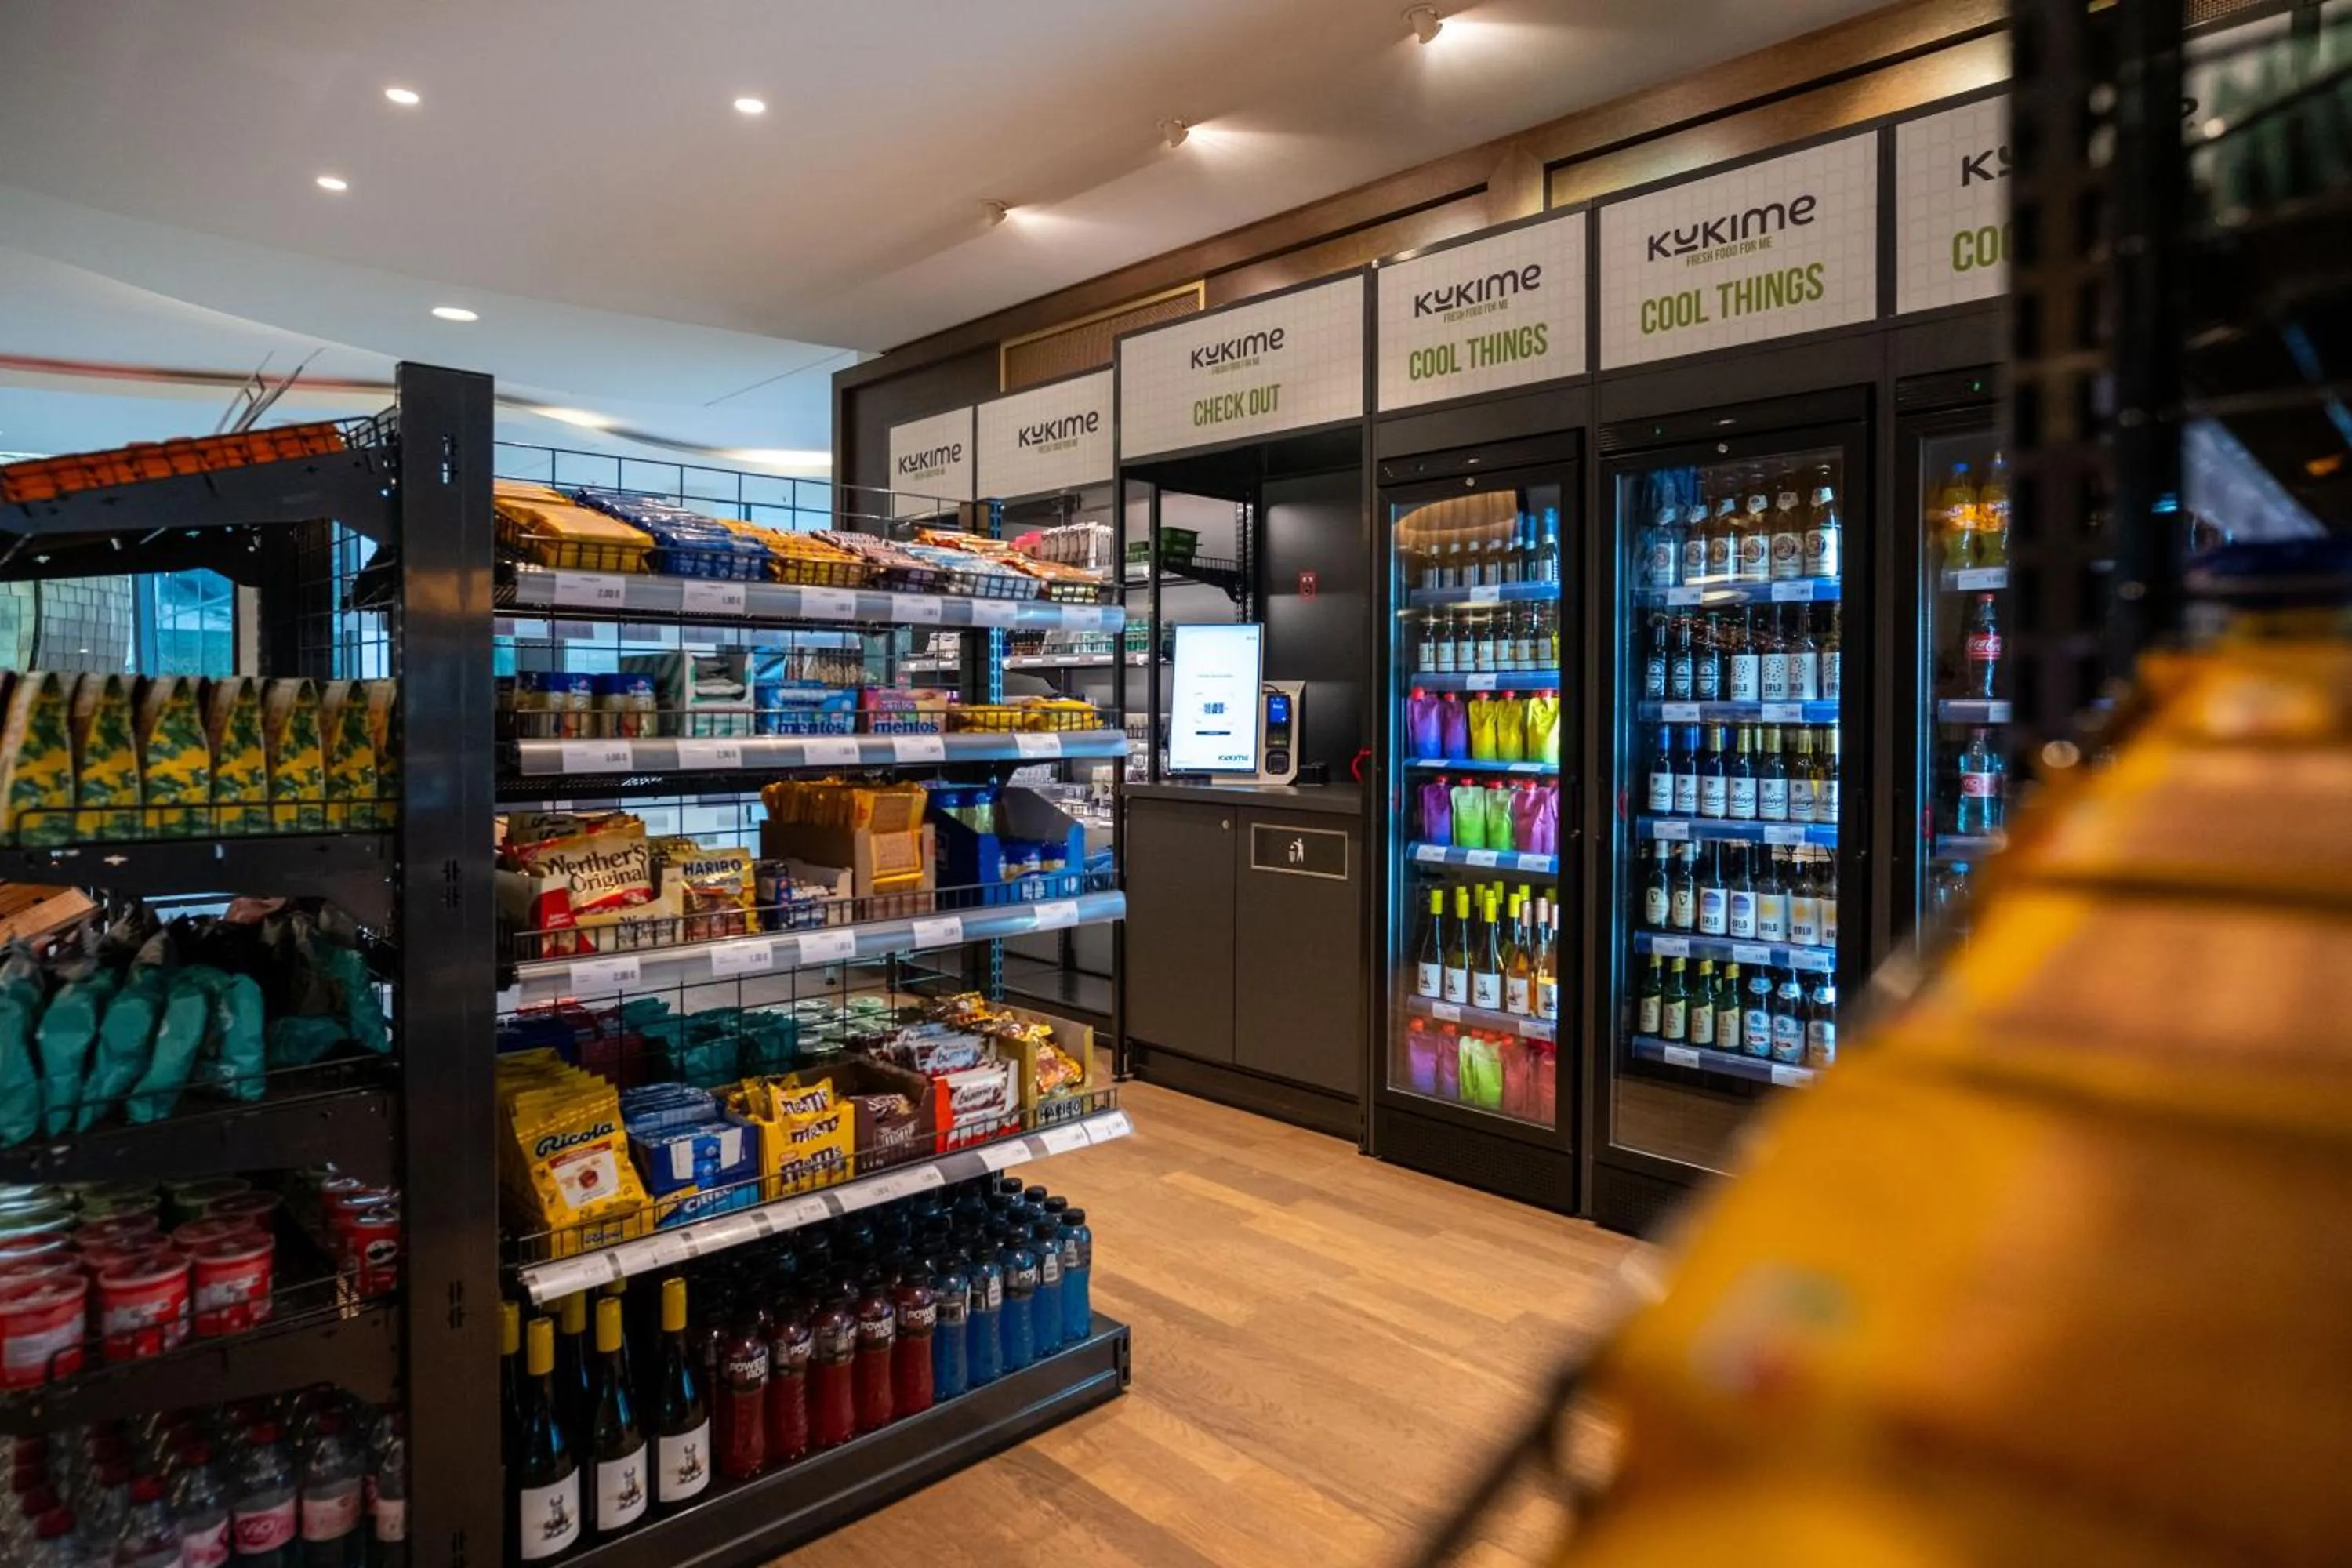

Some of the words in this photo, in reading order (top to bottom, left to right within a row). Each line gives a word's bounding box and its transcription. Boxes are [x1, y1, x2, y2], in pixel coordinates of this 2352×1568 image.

[1686, 250, 1713, 267] FRESH
[1715, 245, 1738, 260] FOOD
[1740, 240, 1757, 255] FOR
[1759, 236, 1773, 249] ME
[1641, 289, 1709, 335] COOL
[1716, 263, 1824, 318] THINGS
[1410, 343, 1461, 381] COOL
[1467, 322, 1548, 369] THINGS
[1194, 390, 1244, 426] CHECK
[1249, 383, 1282, 416] OUT
[778, 720, 847, 735] mentos
[873, 720, 938, 735] mentos
[542, 843, 648, 876] Werther's
[683, 859, 742, 876] HARIBO
[570, 861, 648, 892] Original
[535, 1121, 615, 1158] Ricola
